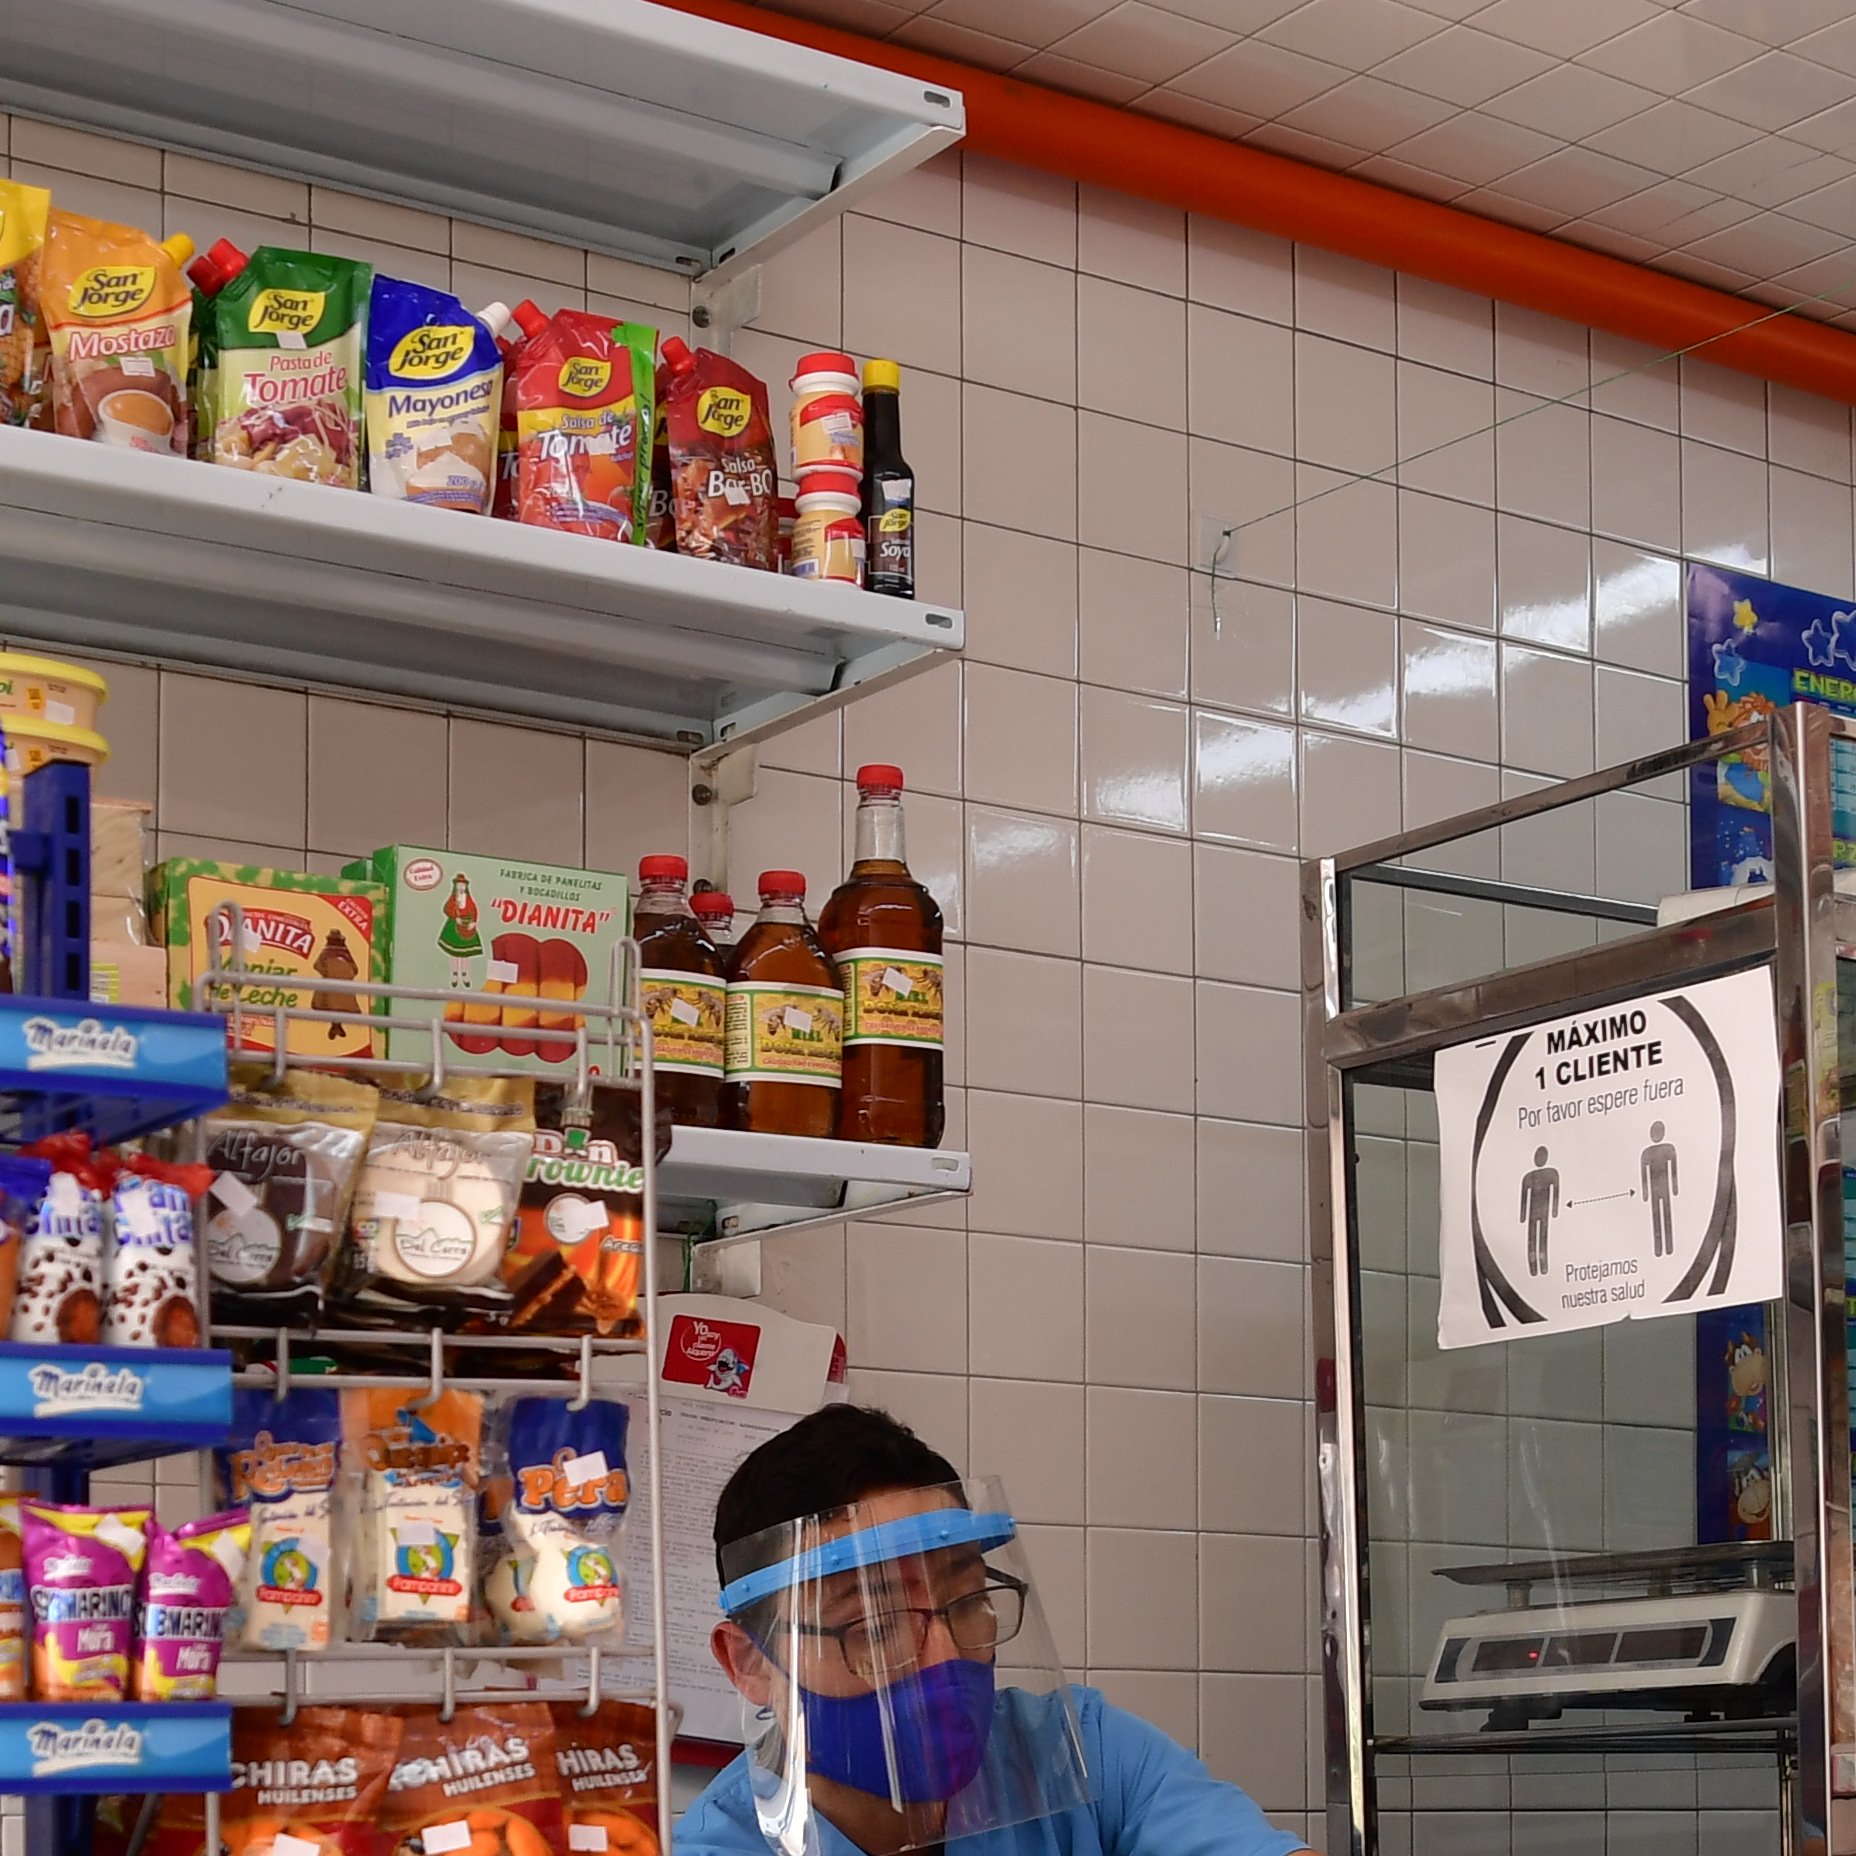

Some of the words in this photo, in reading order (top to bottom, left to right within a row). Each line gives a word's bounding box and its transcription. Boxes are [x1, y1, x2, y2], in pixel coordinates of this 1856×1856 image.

[90, 271, 138, 291] San
[75, 282, 145, 309] Jorge
[268, 292, 309, 312] San
[254, 307, 315, 331] Jorge
[68, 321, 176, 362] Mostaza
[412, 330, 458, 353] San
[269, 354, 312, 372] Pasta
[312, 350, 332, 368] de
[394, 346, 464, 372] Jorge
[568, 361, 601, 379] San
[244, 363, 346, 406] Tomate
[563, 372, 608, 393] Jorge
[388, 379, 494, 419] Mayonesa
[561, 413, 594, 430] Salsa
[598, 410, 616, 425] de
[702, 404, 744, 431] Jorge
[538, 424, 632, 462] Tomate
[721, 456, 756, 473] Salsa
[880, 541, 911, 560] Soya
[499, 868, 539, 884] FABRICA
[555, 876, 603, 891] PANELITAS
[22, 1016, 137, 1062] Marinela
[1546, 1009, 1647, 1056] MÁXIMO
[1535, 1066, 1546, 1090] 1
[1556, 1040, 1663, 1086] CLIENTE
[1517, 1104, 1543, 1129] Por
[1546, 1097, 1583, 1124] favor
[1587, 1087, 1638, 1119] espere
[1643, 1076, 1684, 1104] fuera
[208, 1129, 305, 1180] Alfajor
[391, 1130, 485, 1180] Alfajor
[1565, 1259, 1639, 1284] Protejamos
[1561, 1286, 1608, 1309] nuestra
[1610, 1280, 1645, 1303] salud
[692, 1321, 708, 1335] Yo
[28, 1361, 141, 1402] Marinela
[76, 1625, 115, 1652] Mora
[176, 1645, 212, 1671] Mora
[25, 1718, 141, 1760] Marinela
[442, 1762, 536, 1797] HUILENSES
[257, 1786, 358, 1805] HUILENSES
